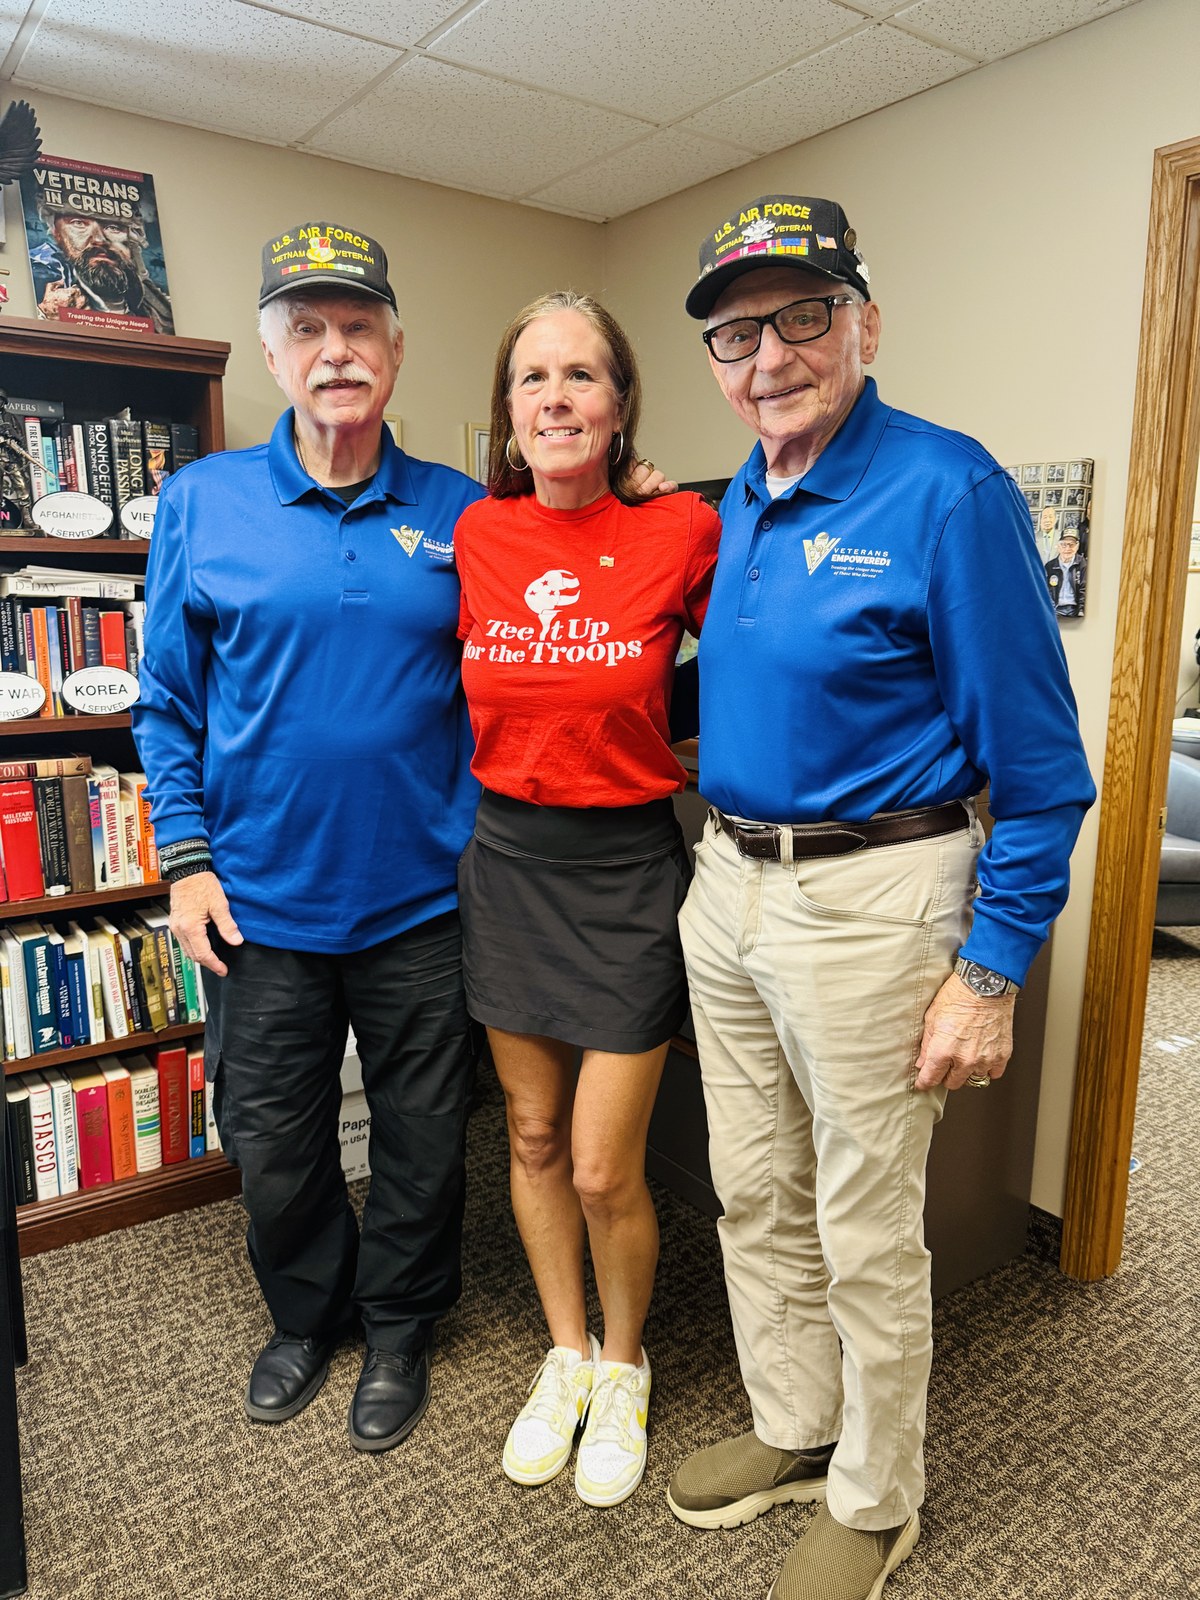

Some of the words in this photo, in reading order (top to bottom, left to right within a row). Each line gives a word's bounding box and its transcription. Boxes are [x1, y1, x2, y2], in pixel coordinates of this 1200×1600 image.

[33, 168, 140, 201] VETERANS
[45, 190, 61, 204] IN
[68, 194, 133, 218] CRISIS
[714, 222, 735, 243] U.S.
[738, 207, 760, 226] AIR
[764, 203, 811, 219] FORCE
[272, 235, 294, 252] U.S.
[299, 227, 320, 240] AIR
[326, 227, 369, 252] FORCE
[715, 234, 744, 255] VIETNAM
[774, 224, 812, 233] VETERAN
[271, 250, 305, 264] VIETNAM
[336, 250, 374, 264] VETERAN
[67, 312, 94, 322] Treating
[106, 317, 128, 326] Unique
[29, 426, 38, 439] FIRE
[34, 463, 42, 478] OLE!
[129, 449, 143, 488] LONG
[40, 510, 105, 521] AFGHANIST
[131, 512, 156, 522] VIET
[56, 529, 94, 538] SERVED
[834, 547, 888, 557] VETERANS
[15, 581, 58, 592] D-DAY
[486, 619, 535, 641] Tee
[568, 617, 609, 643] Up
[463, 640, 485, 660] for
[489, 644, 525, 663] the
[528, 639, 642, 666] Troops
[8, 688, 41, 699] WAR
[75, 684, 128, 696] KOREA
[88, 701, 125, 712] SERVED
[45, 786, 56, 819] WORLD
[3, 811, 34, 819] MILITARY
[90, 799, 101, 828] WAR
[105, 803, 116, 835] BARBARA
[49, 820, 58, 840] WAR
[58, 831, 63, 840] OF
[125, 814, 136, 847] Whistle
[108, 843, 120, 874] TUCHMAN
[158, 937, 167, 952] DARK
[36, 945, 47, 967] BATTLE
[160, 953, 169, 968] SIDE
[38, 967, 48, 978] CRY
[105, 948, 116, 977] DESTINED
[114, 1004, 123, 1028] ALLISON
[163, 978, 173, 990] SUN
[39, 987, 51, 1015] FREEDOM
[61, 1090, 72, 1115] THOMAS
[168, 1079, 181, 1149] DICTIONARY
[65, 1126, 74, 1144] RICKS
[342, 1117, 371, 1133] Pape
[33, 1112, 56, 1173] FIASCO
[350, 1133, 367, 1144] USA
[66, 1145, 75, 1157] THE
[68, 1159, 77, 1183] GAMBLE
